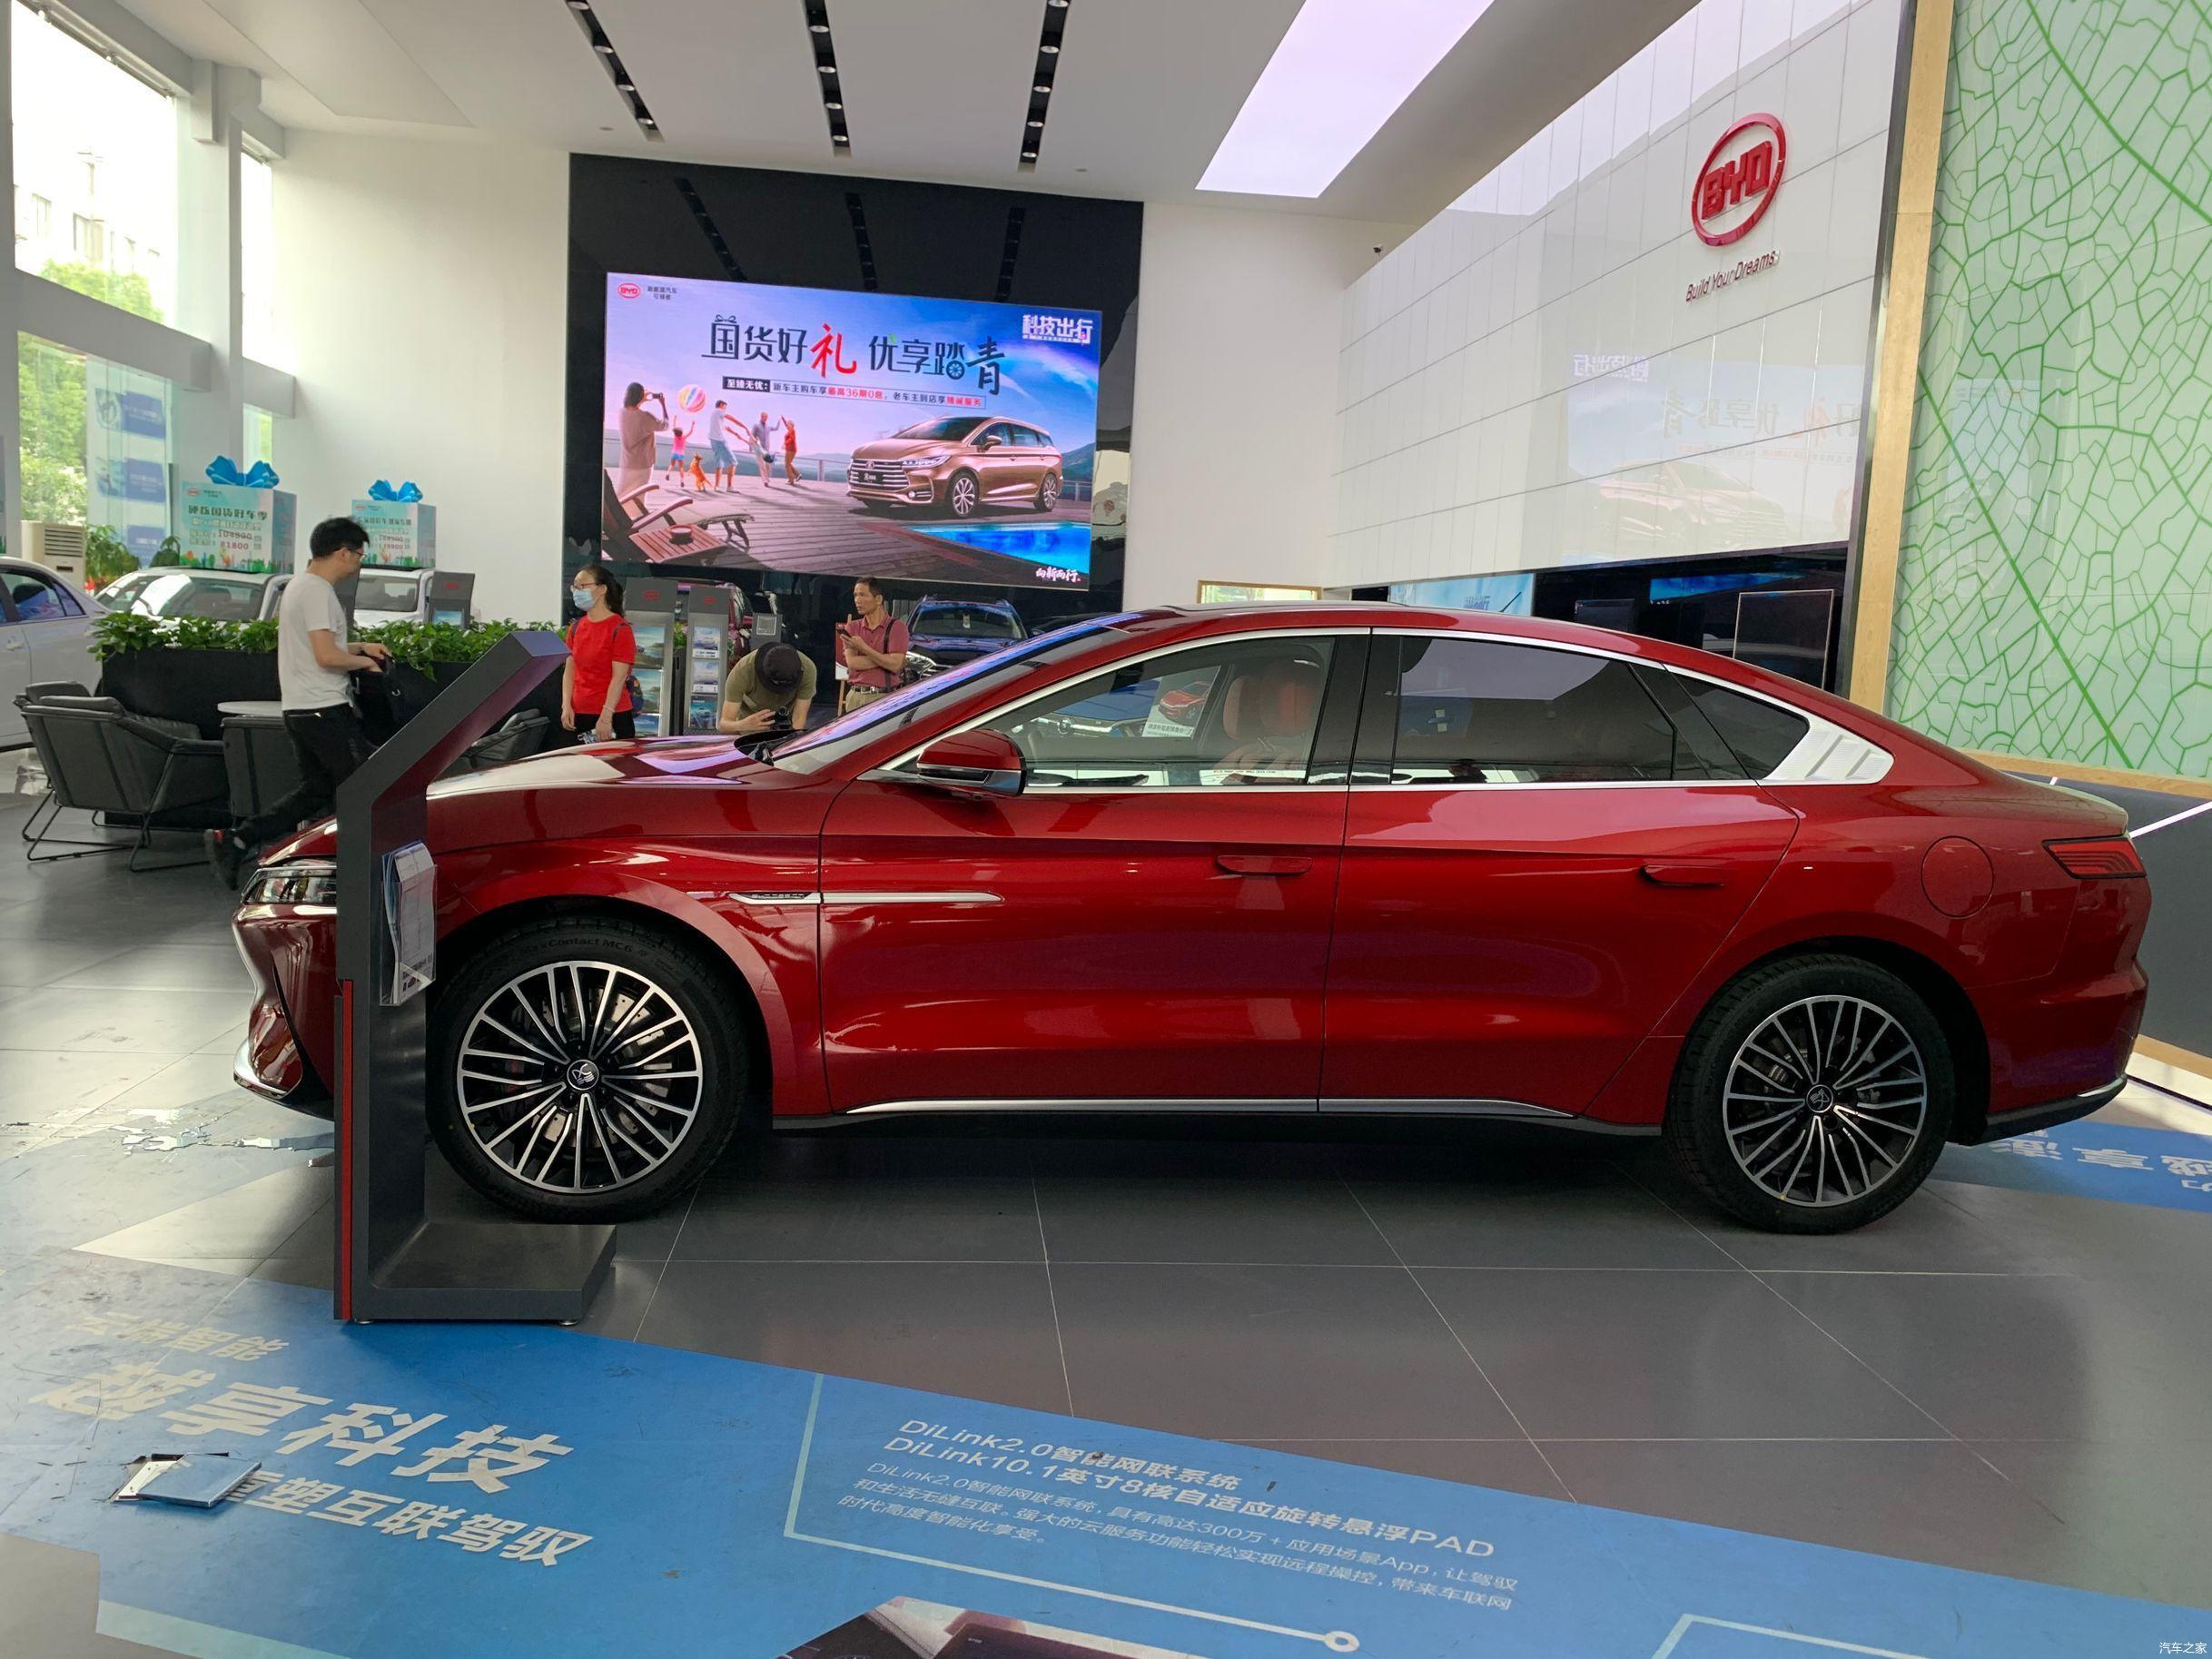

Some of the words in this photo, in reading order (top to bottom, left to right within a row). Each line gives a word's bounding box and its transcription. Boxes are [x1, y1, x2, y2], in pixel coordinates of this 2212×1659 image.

[1702, 141, 1773, 220] BYD
[1685, 278, 1710, 302] Build
[1712, 268, 1735, 291] Your
[1734, 249, 1778, 281] Dreams
[701, 313, 857, 378] 国货好礼
[868, 334, 1005, 396] 优享踏青
[1022, 314, 1093, 343] 科技出行
[1036, 566, 1078, 582] 向新而行
